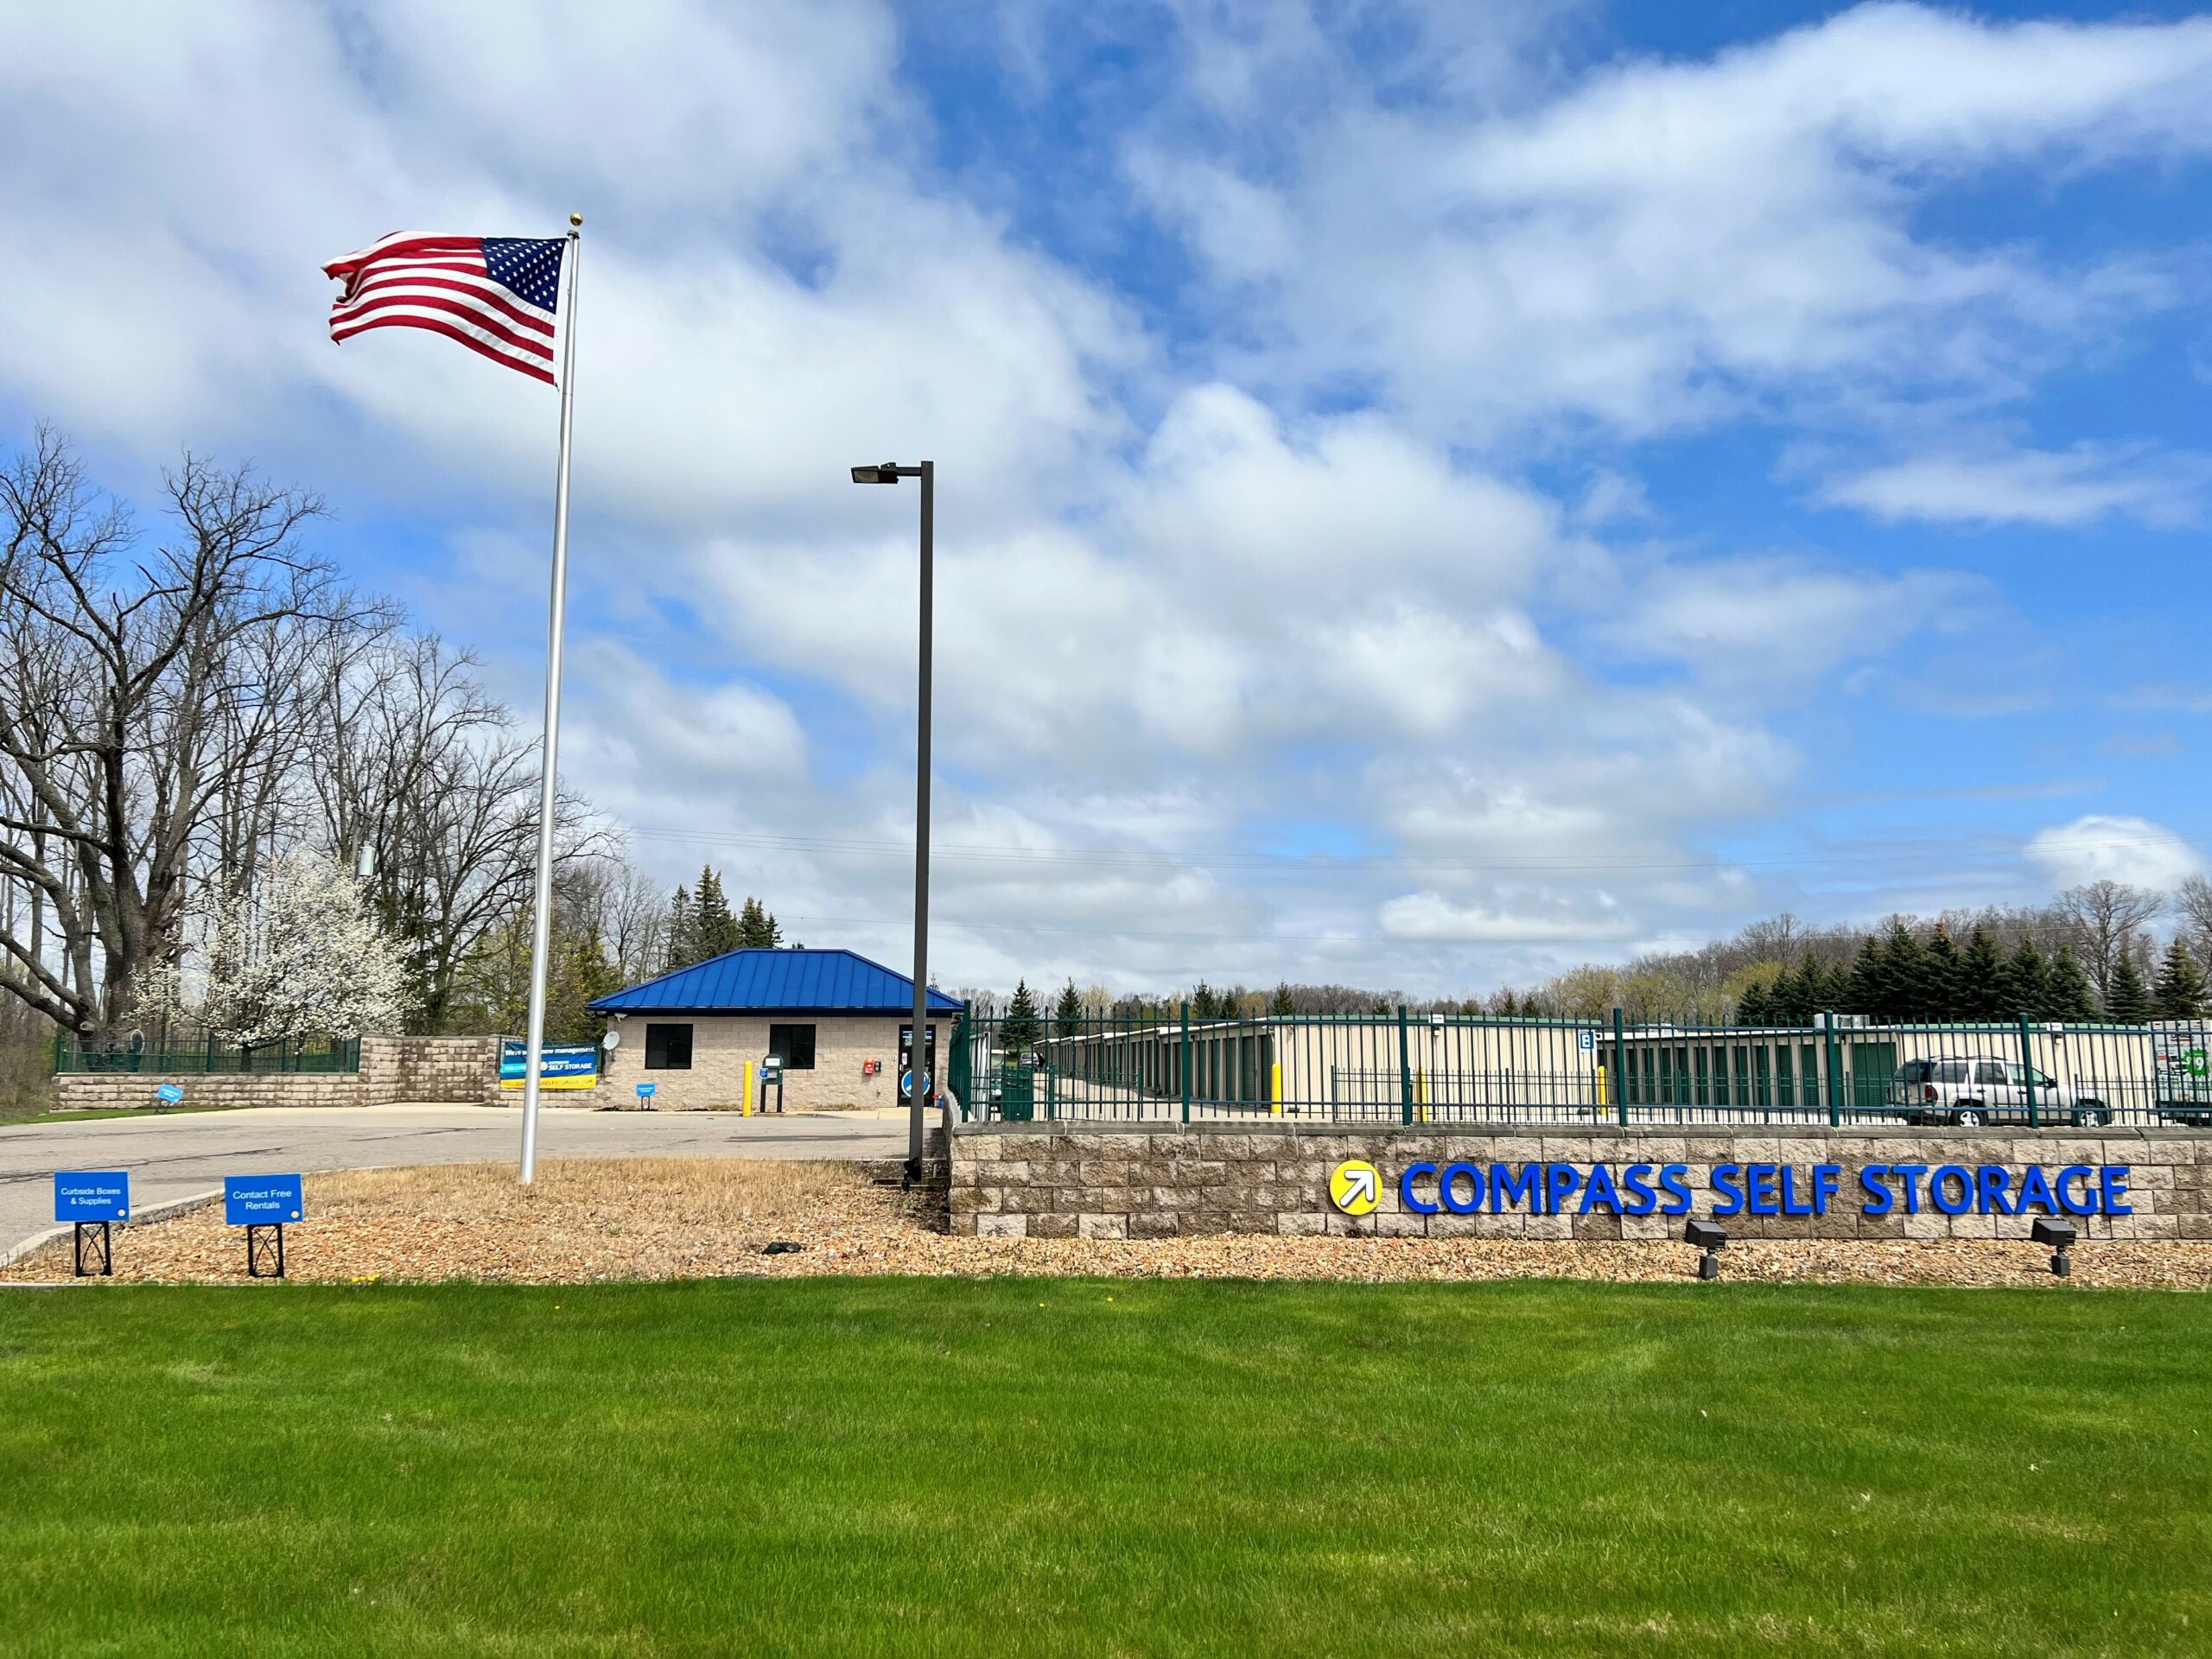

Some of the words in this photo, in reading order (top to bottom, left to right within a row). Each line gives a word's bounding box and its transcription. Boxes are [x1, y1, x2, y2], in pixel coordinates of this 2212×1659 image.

[1582, 1034, 1591, 1047] B
[60, 1187, 95, 1196] Curbside
[232, 1191, 269, 1199] Contact
[270, 1189, 292, 1198] Free
[1401, 1162, 1693, 1214] COMPASS
[1711, 1164, 1841, 1215] SELF
[1860, 1165, 2133, 1216] STORAGE
[70, 1197, 77, 1205] &
[78, 1197, 111, 1206] Supplies
[245, 1201, 281, 1211] Rentals
